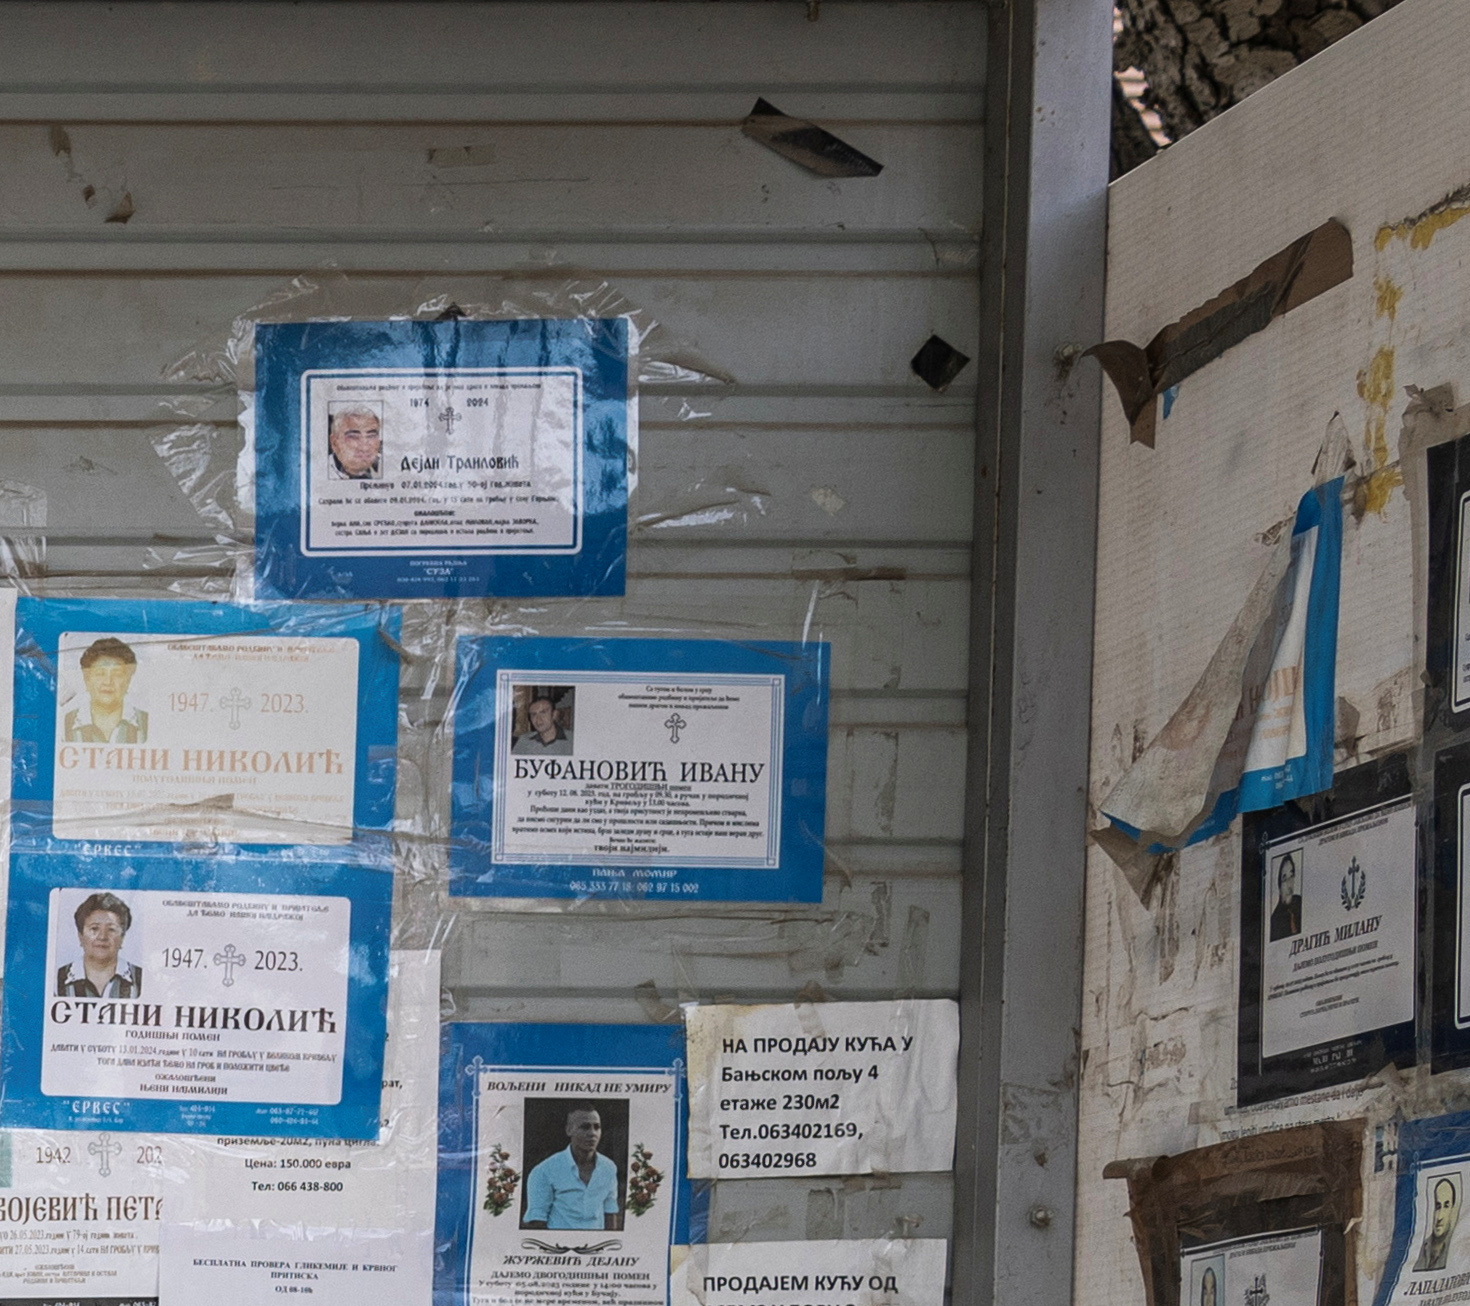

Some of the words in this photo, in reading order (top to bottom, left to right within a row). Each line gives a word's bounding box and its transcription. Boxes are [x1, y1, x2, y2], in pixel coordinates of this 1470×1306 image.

[401, 456, 440, 473] Дејан
[59, 746, 168, 770] СТАНИ
[183, 749, 344, 774] НИКОЛИЋ
[515, 759, 667, 781] БУФАНОВИЋ
[680, 762, 765, 782] ИВАНУ
[1290, 930, 1331, 957] ДРАГИЋ
[1334, 915, 1382, 943] МИЛАНУ
[51, 1001, 162, 1026] СТАНИ
[175, 1005, 337, 1033] НИКОЛИЋ
[723, 1039, 747, 1053] НА
[754, 1037, 839, 1056] ПРОДАЈУ
[845, 1036, 896, 1051] КУЋА
[901, 1036, 913, 1051] У
[722, 1066, 807, 1082] Бањском
[813, 1069, 862, 1083] пољу
[868, 1065, 878, 1079] 4
[720, 1096, 776, 1110] етаже
[783, 1094, 839, 1110] 230м2
[720, 1123, 863, 1140] Тел.063402169,
[719, 1154, 816, 1168] 063402968
[252, 1181, 274, 1193] Тел:
[278, 1181, 296, 1192] 066
[299, 1181, 343, 1192] 438-800
[502, 1255, 581, 1266] ЖУРЖЕВИЋ
[587, 1257, 639, 1267] ДЕЈАНУ
[704, 1276, 808, 1293] ПРОДАЈЕМ
[815, 1276, 864, 1291] КУЋУ
[869, 1276, 898, 1293] ОД
